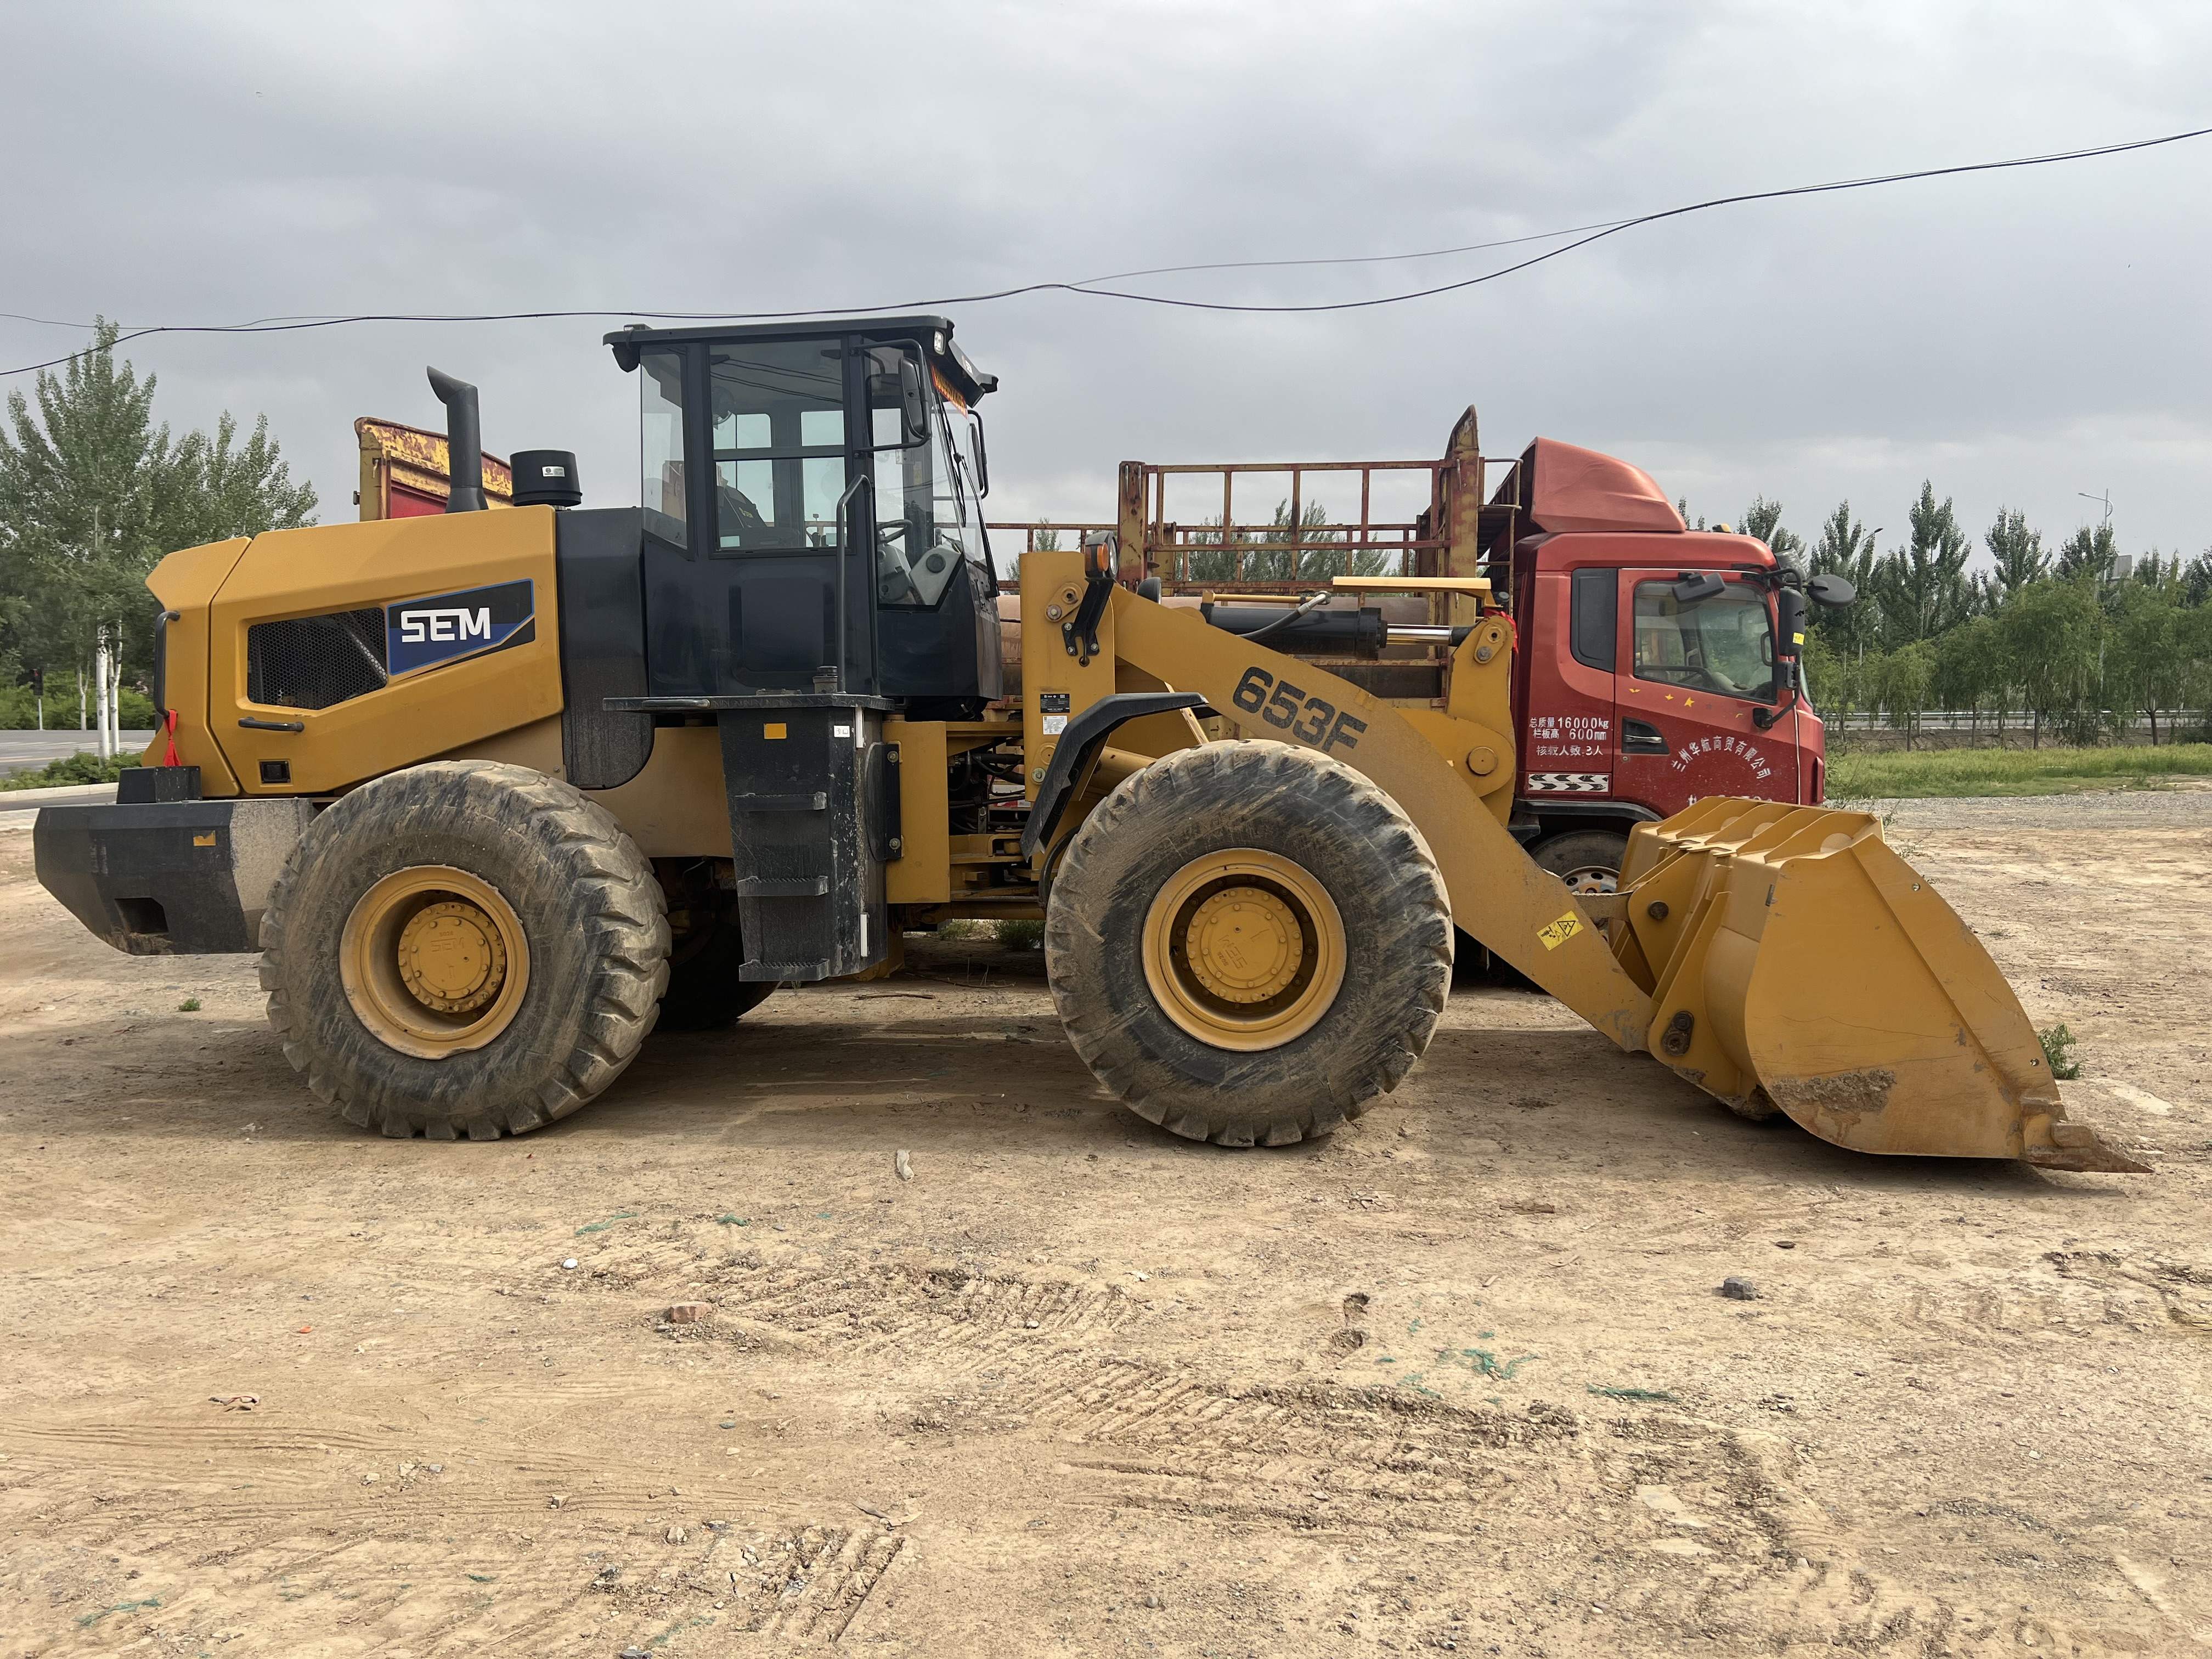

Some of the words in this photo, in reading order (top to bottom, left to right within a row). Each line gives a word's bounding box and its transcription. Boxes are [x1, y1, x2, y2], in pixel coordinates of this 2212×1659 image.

[401, 607, 490, 642] SEM
[1233, 667, 1368, 752] 653F
[1529, 717, 1555, 728] 总质量
[1558, 717, 1609, 729] 16000kg
[1533, 728, 1559, 739] 栏板高
[1569, 728, 1606, 740] 600mm
[1671, 735, 1771, 779] 兰州华航商贸有限公司
